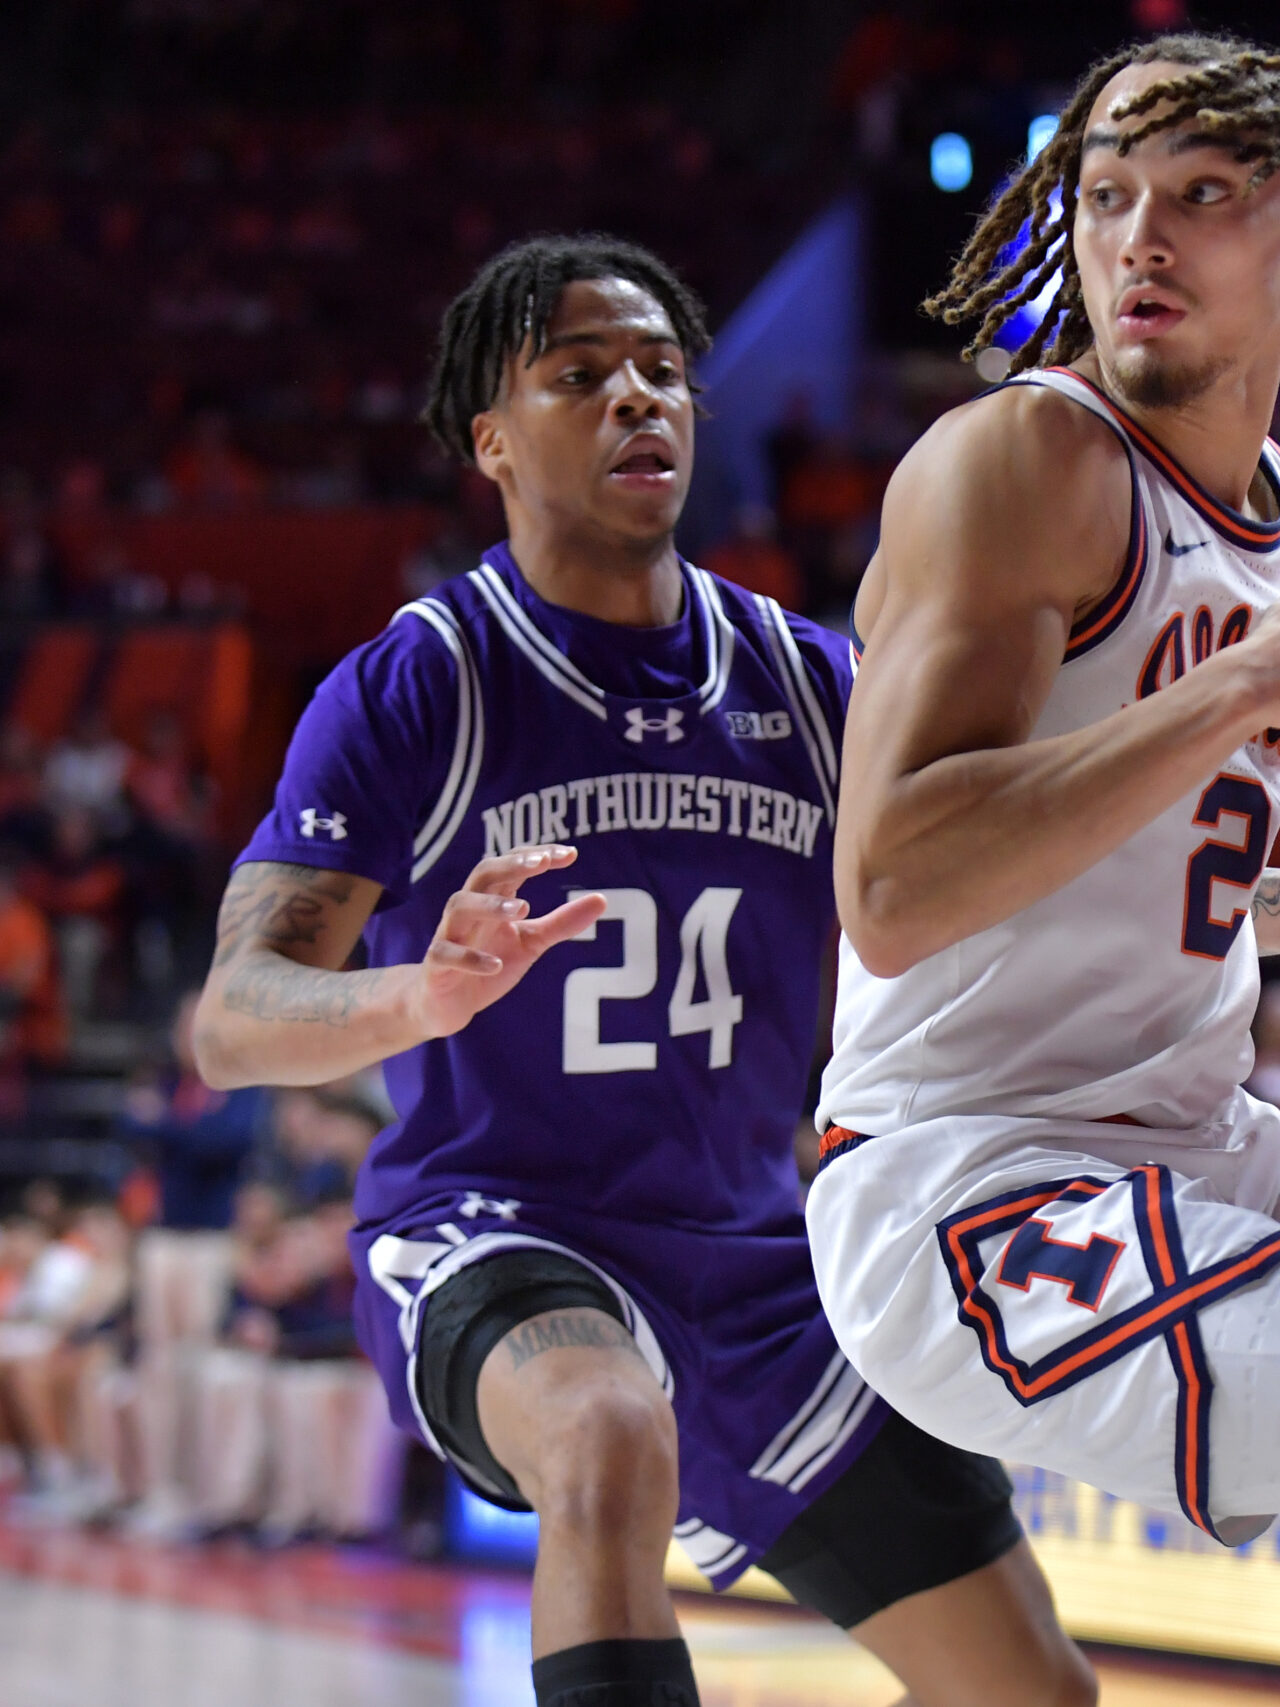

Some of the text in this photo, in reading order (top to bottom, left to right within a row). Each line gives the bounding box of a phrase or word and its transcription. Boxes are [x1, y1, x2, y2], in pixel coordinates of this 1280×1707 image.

[481, 772, 824, 859] NORTHWESTERN
[1181, 772, 1272, 962] 2
[562, 886, 744, 1075] 24
